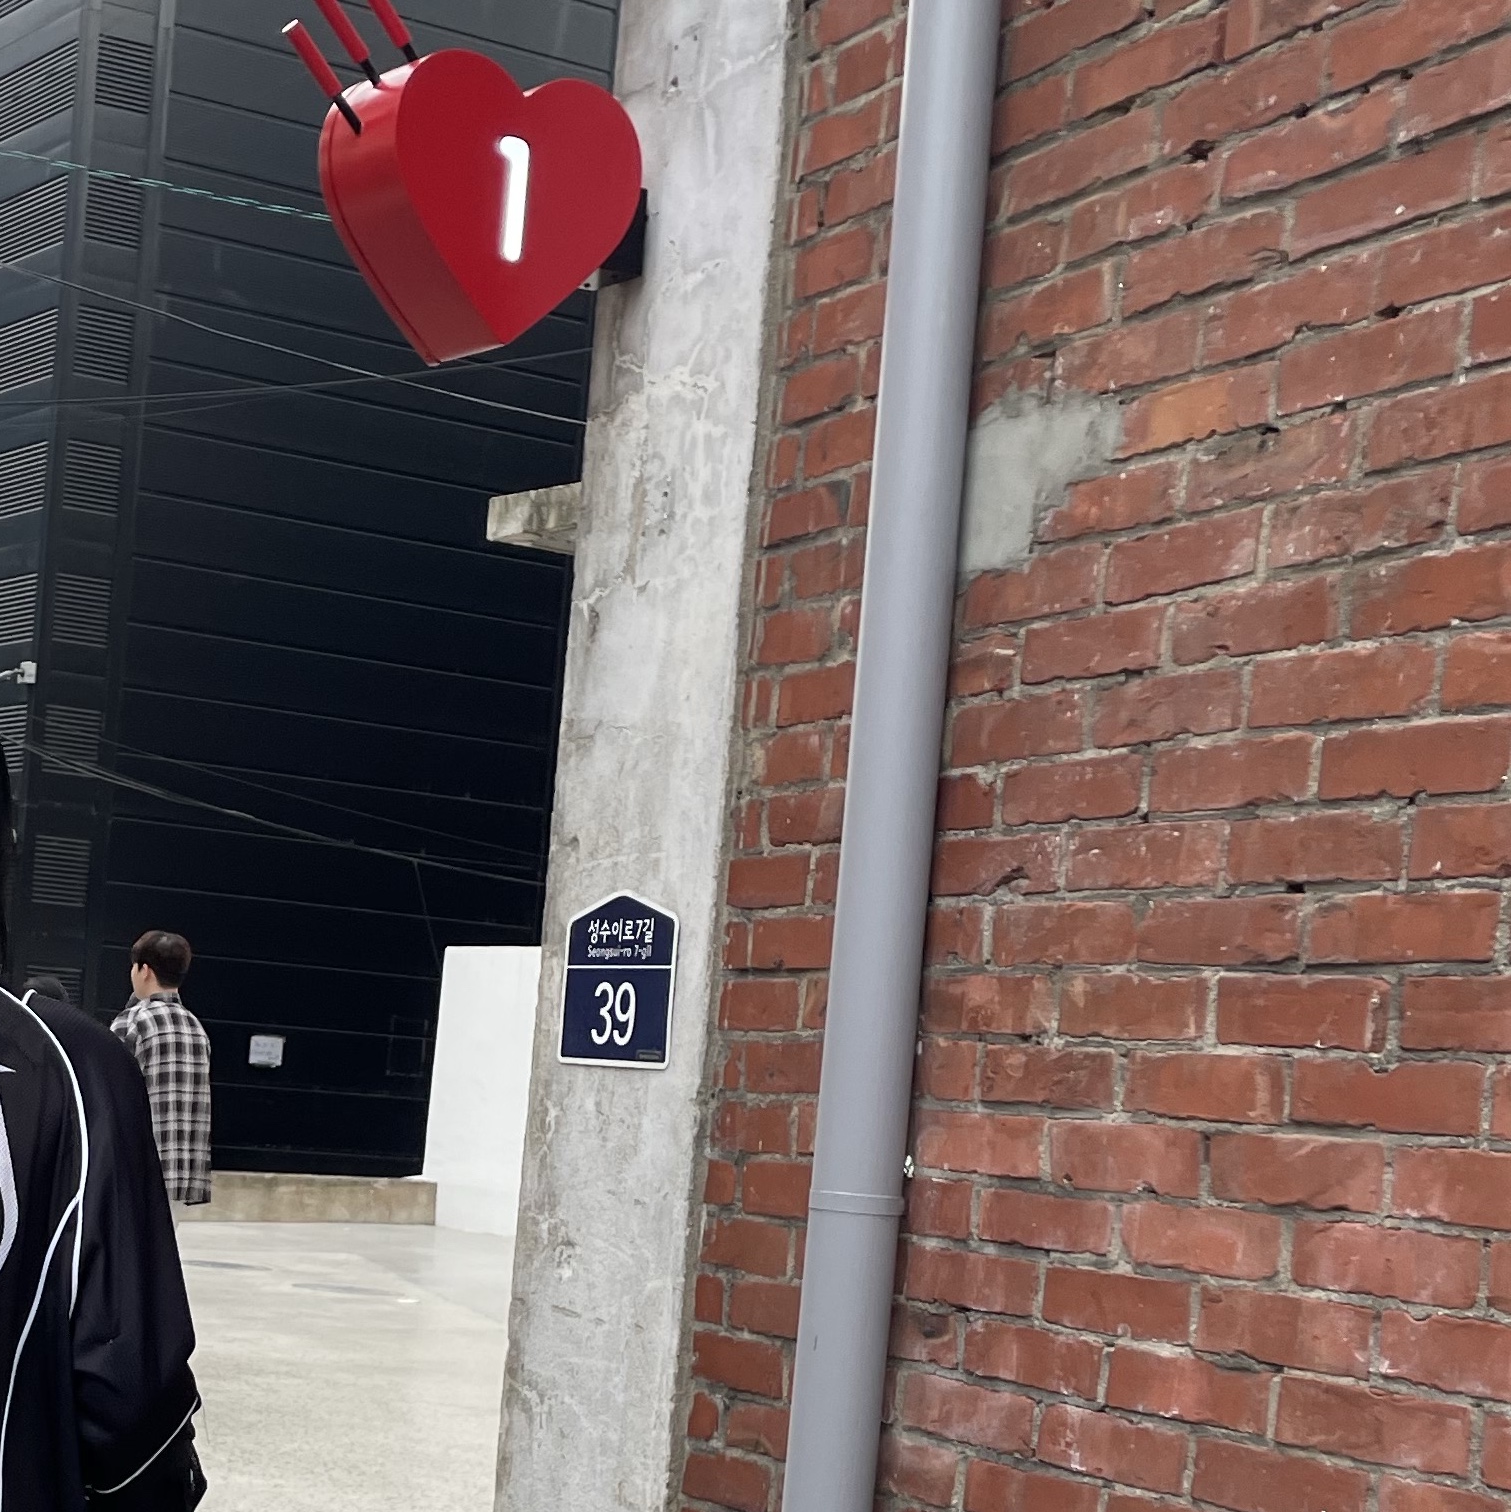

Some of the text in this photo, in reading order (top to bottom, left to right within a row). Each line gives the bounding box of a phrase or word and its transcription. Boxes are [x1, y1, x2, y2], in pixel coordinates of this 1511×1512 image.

[499, 134, 531, 263] 1
[588, 918, 655, 943] 성수이로7길
[591, 981, 637, 1046] 39
